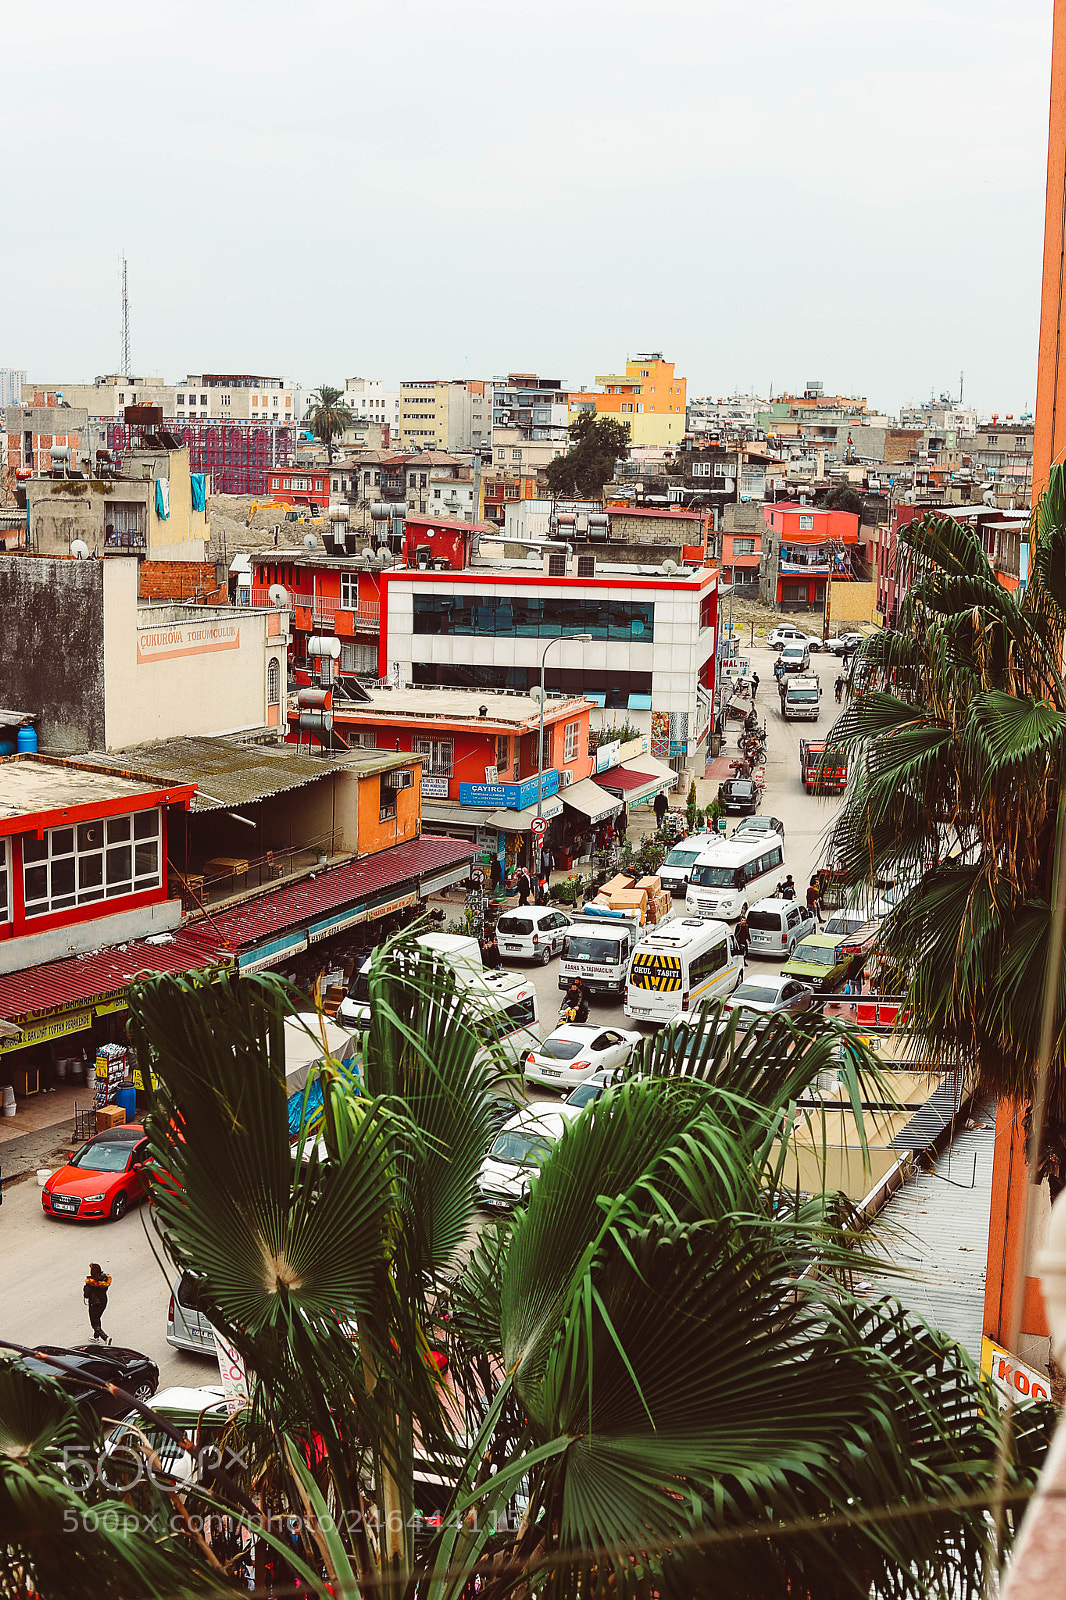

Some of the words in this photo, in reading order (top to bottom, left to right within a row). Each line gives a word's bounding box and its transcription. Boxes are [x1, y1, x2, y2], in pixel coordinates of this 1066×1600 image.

[140, 630, 184, 649] ÇUKUROVA
[187, 626, 236, 642] TOHUMCULUK
[471, 785, 505, 793] ÇAYIRCI
[634, 966, 652, 975] OKUL
[656, 968, 681, 978] TAŞITI
